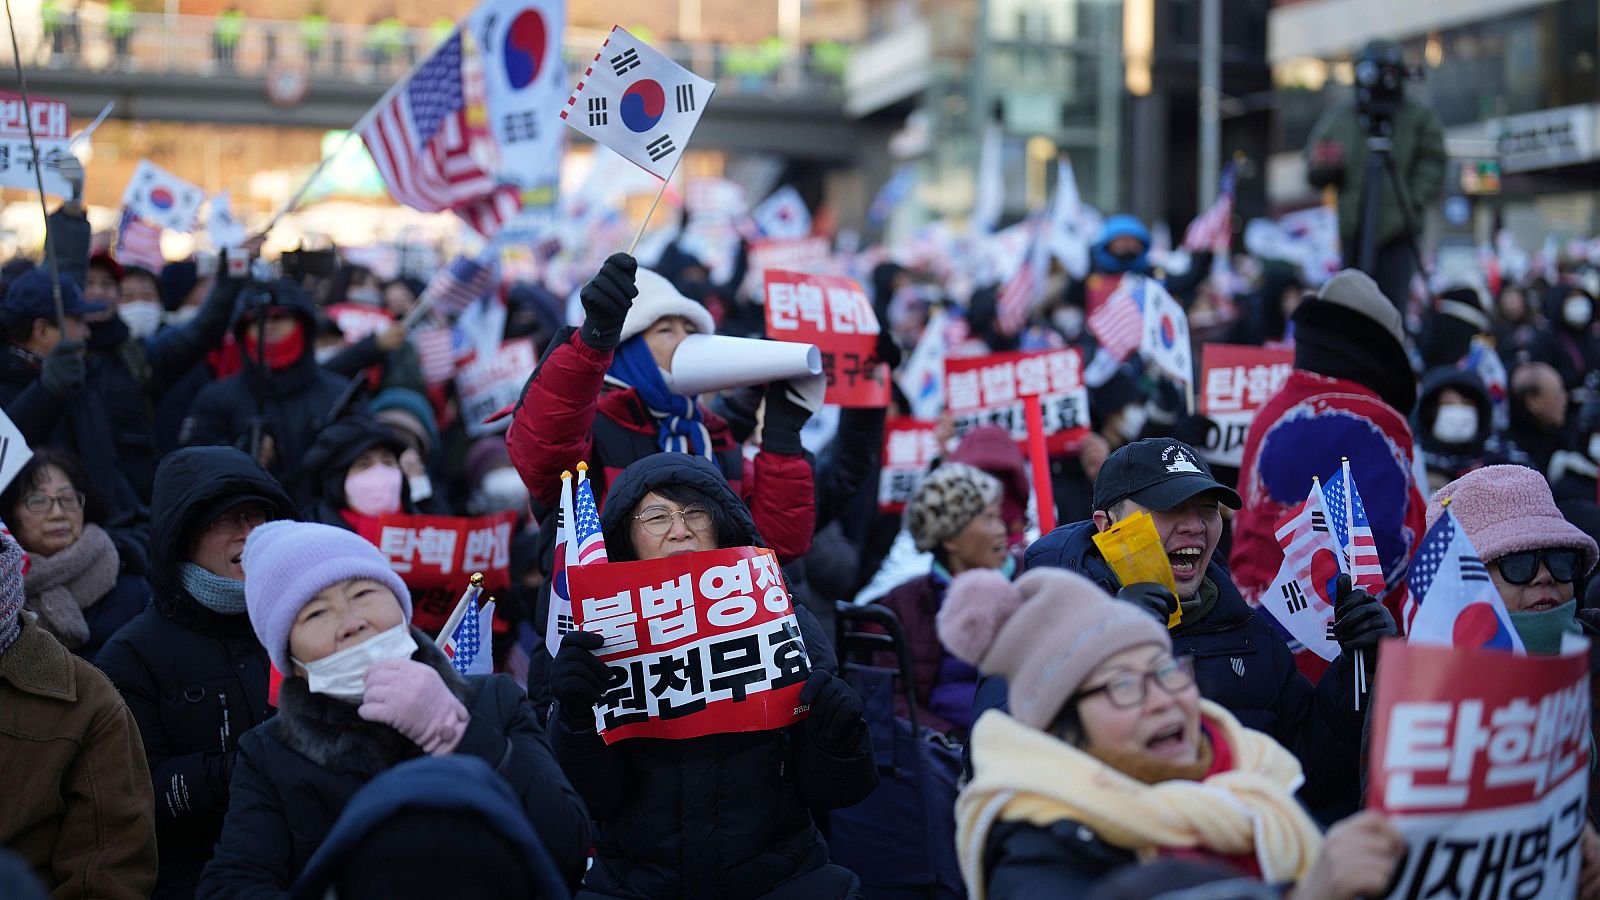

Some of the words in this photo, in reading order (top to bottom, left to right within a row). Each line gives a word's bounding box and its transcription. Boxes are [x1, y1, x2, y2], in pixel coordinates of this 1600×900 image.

[768, 282, 826, 332] 탄핵
[949, 349, 1080, 409] 불법영장
[381, 525, 457, 574] 탄핵
[582, 553, 789, 655] 불법영장
[600, 621, 813, 733] 원천무효
